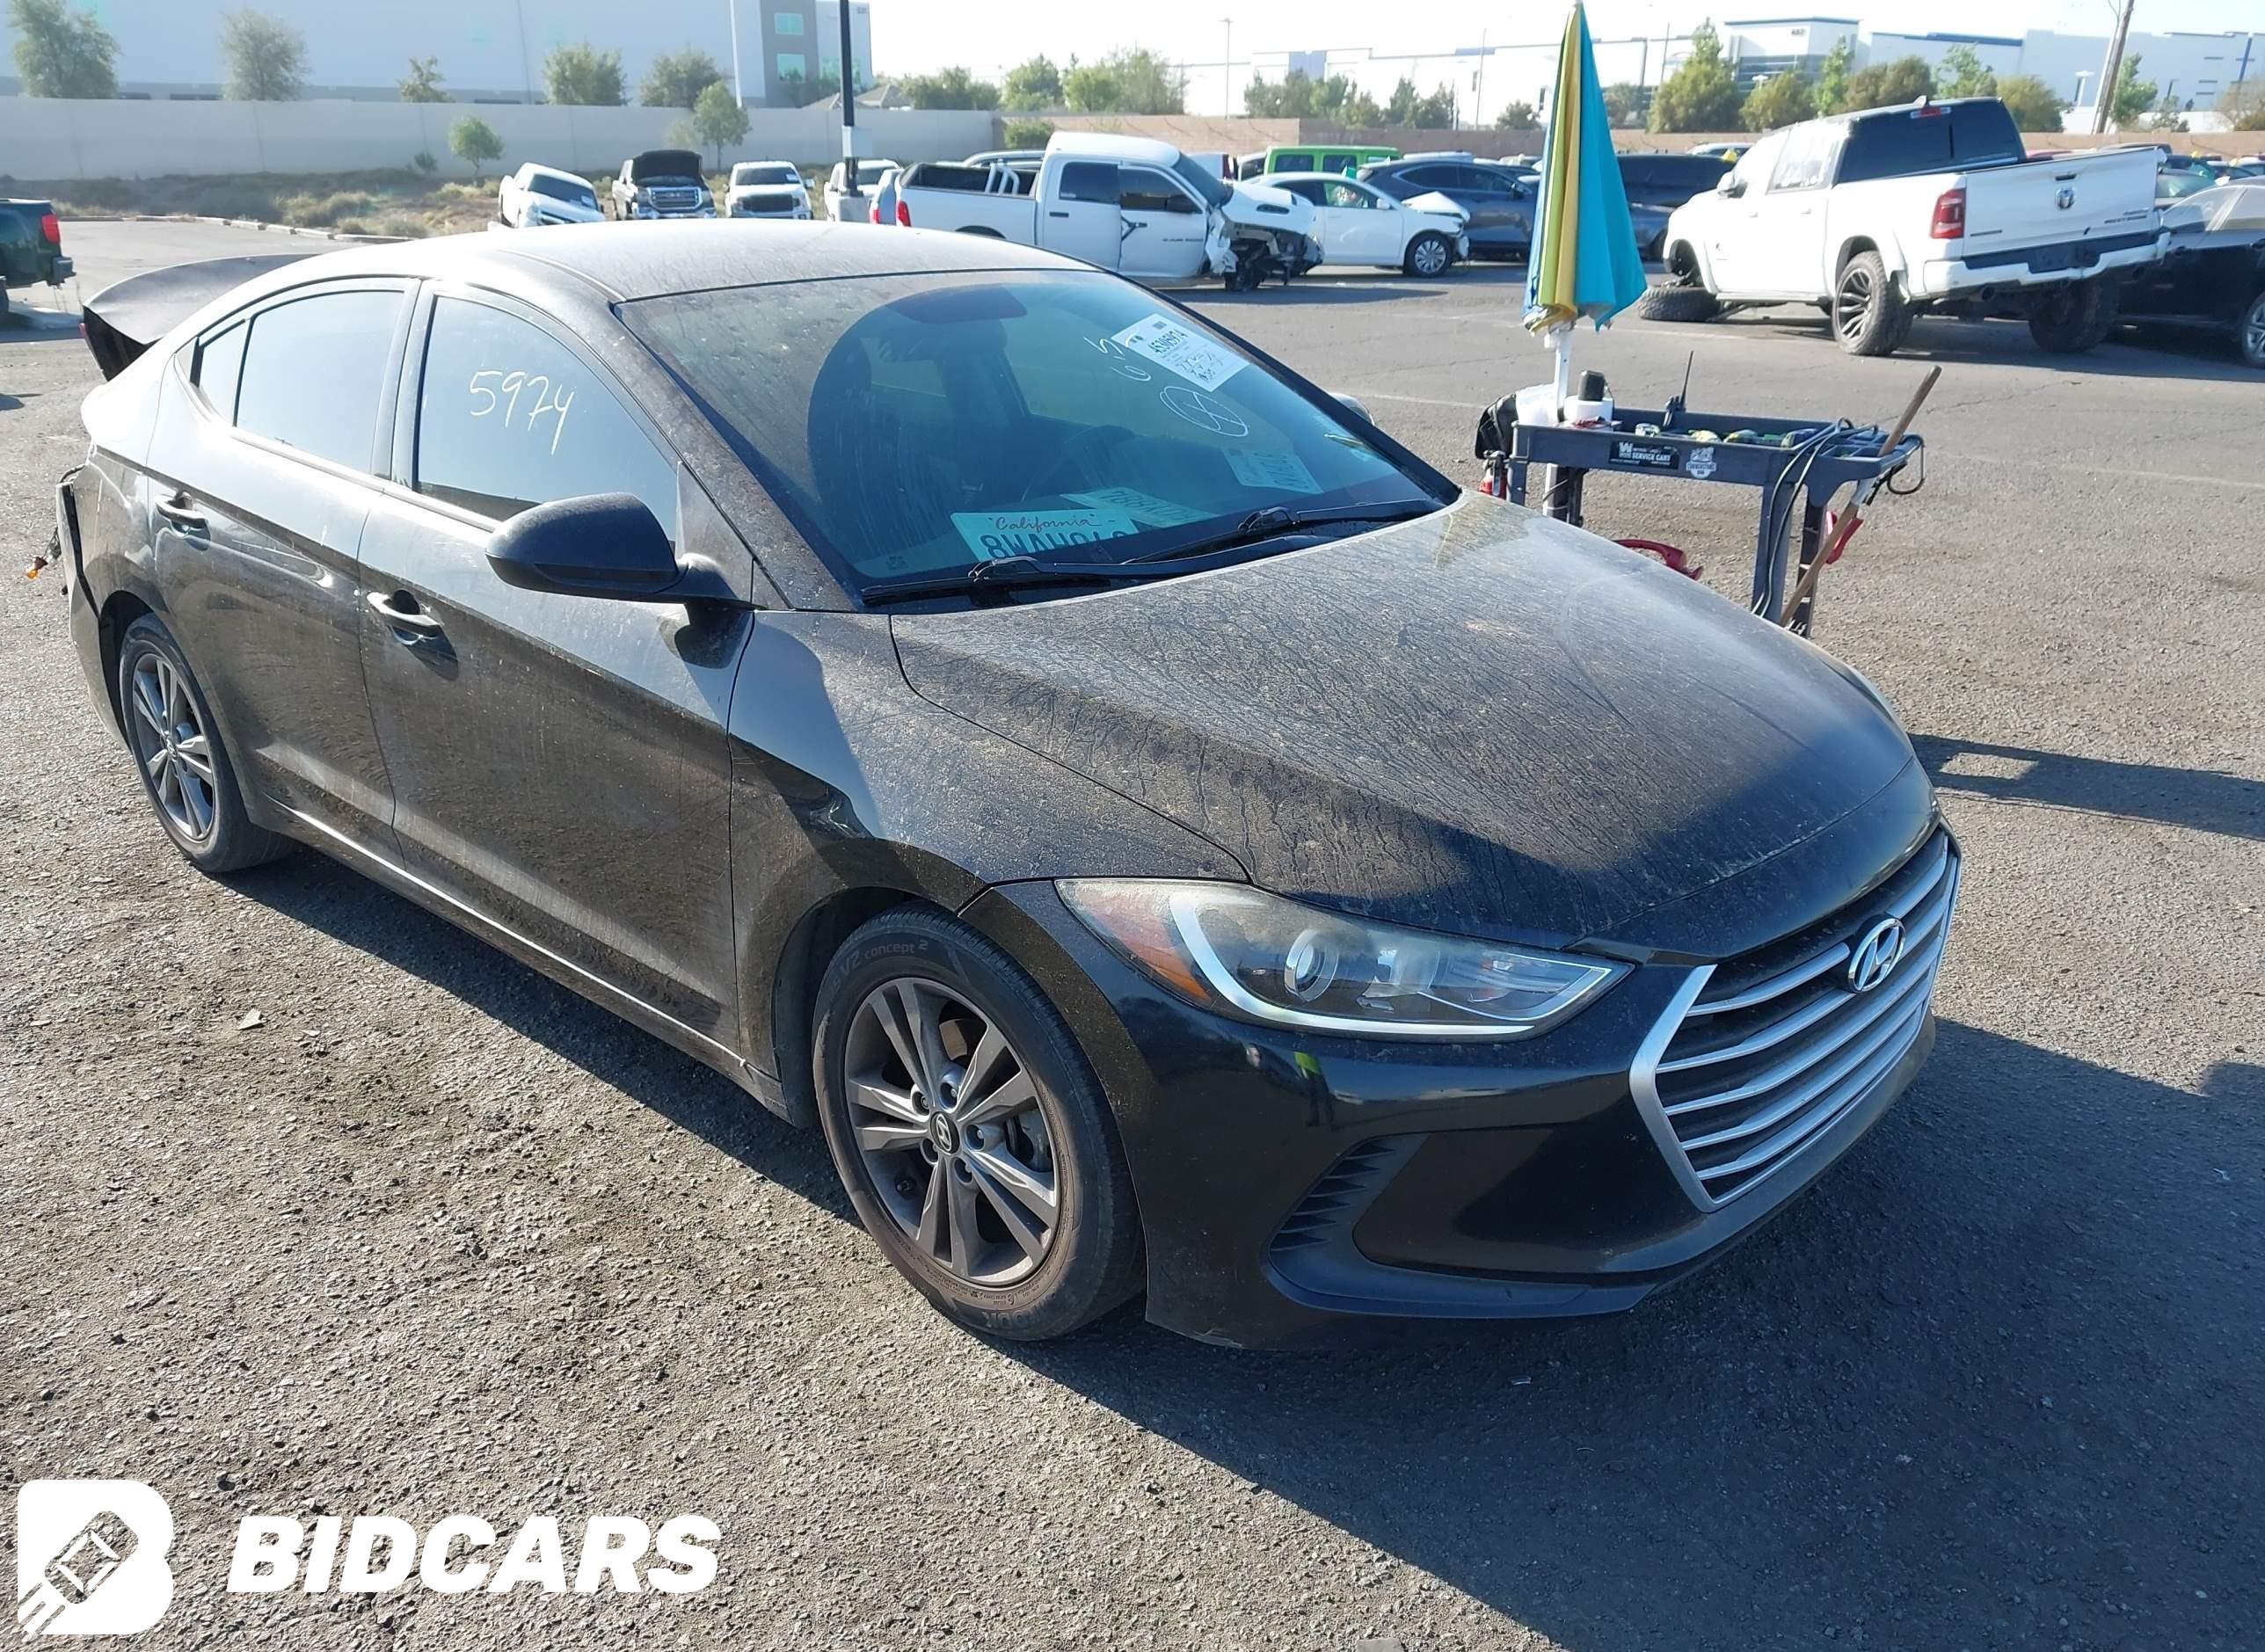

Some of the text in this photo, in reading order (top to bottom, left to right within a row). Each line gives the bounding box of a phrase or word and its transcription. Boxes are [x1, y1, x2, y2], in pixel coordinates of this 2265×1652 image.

[470, 370, 575, 455] 5974
[994, 515, 1102, 533] California
[864, 942, 915, 960] concept
